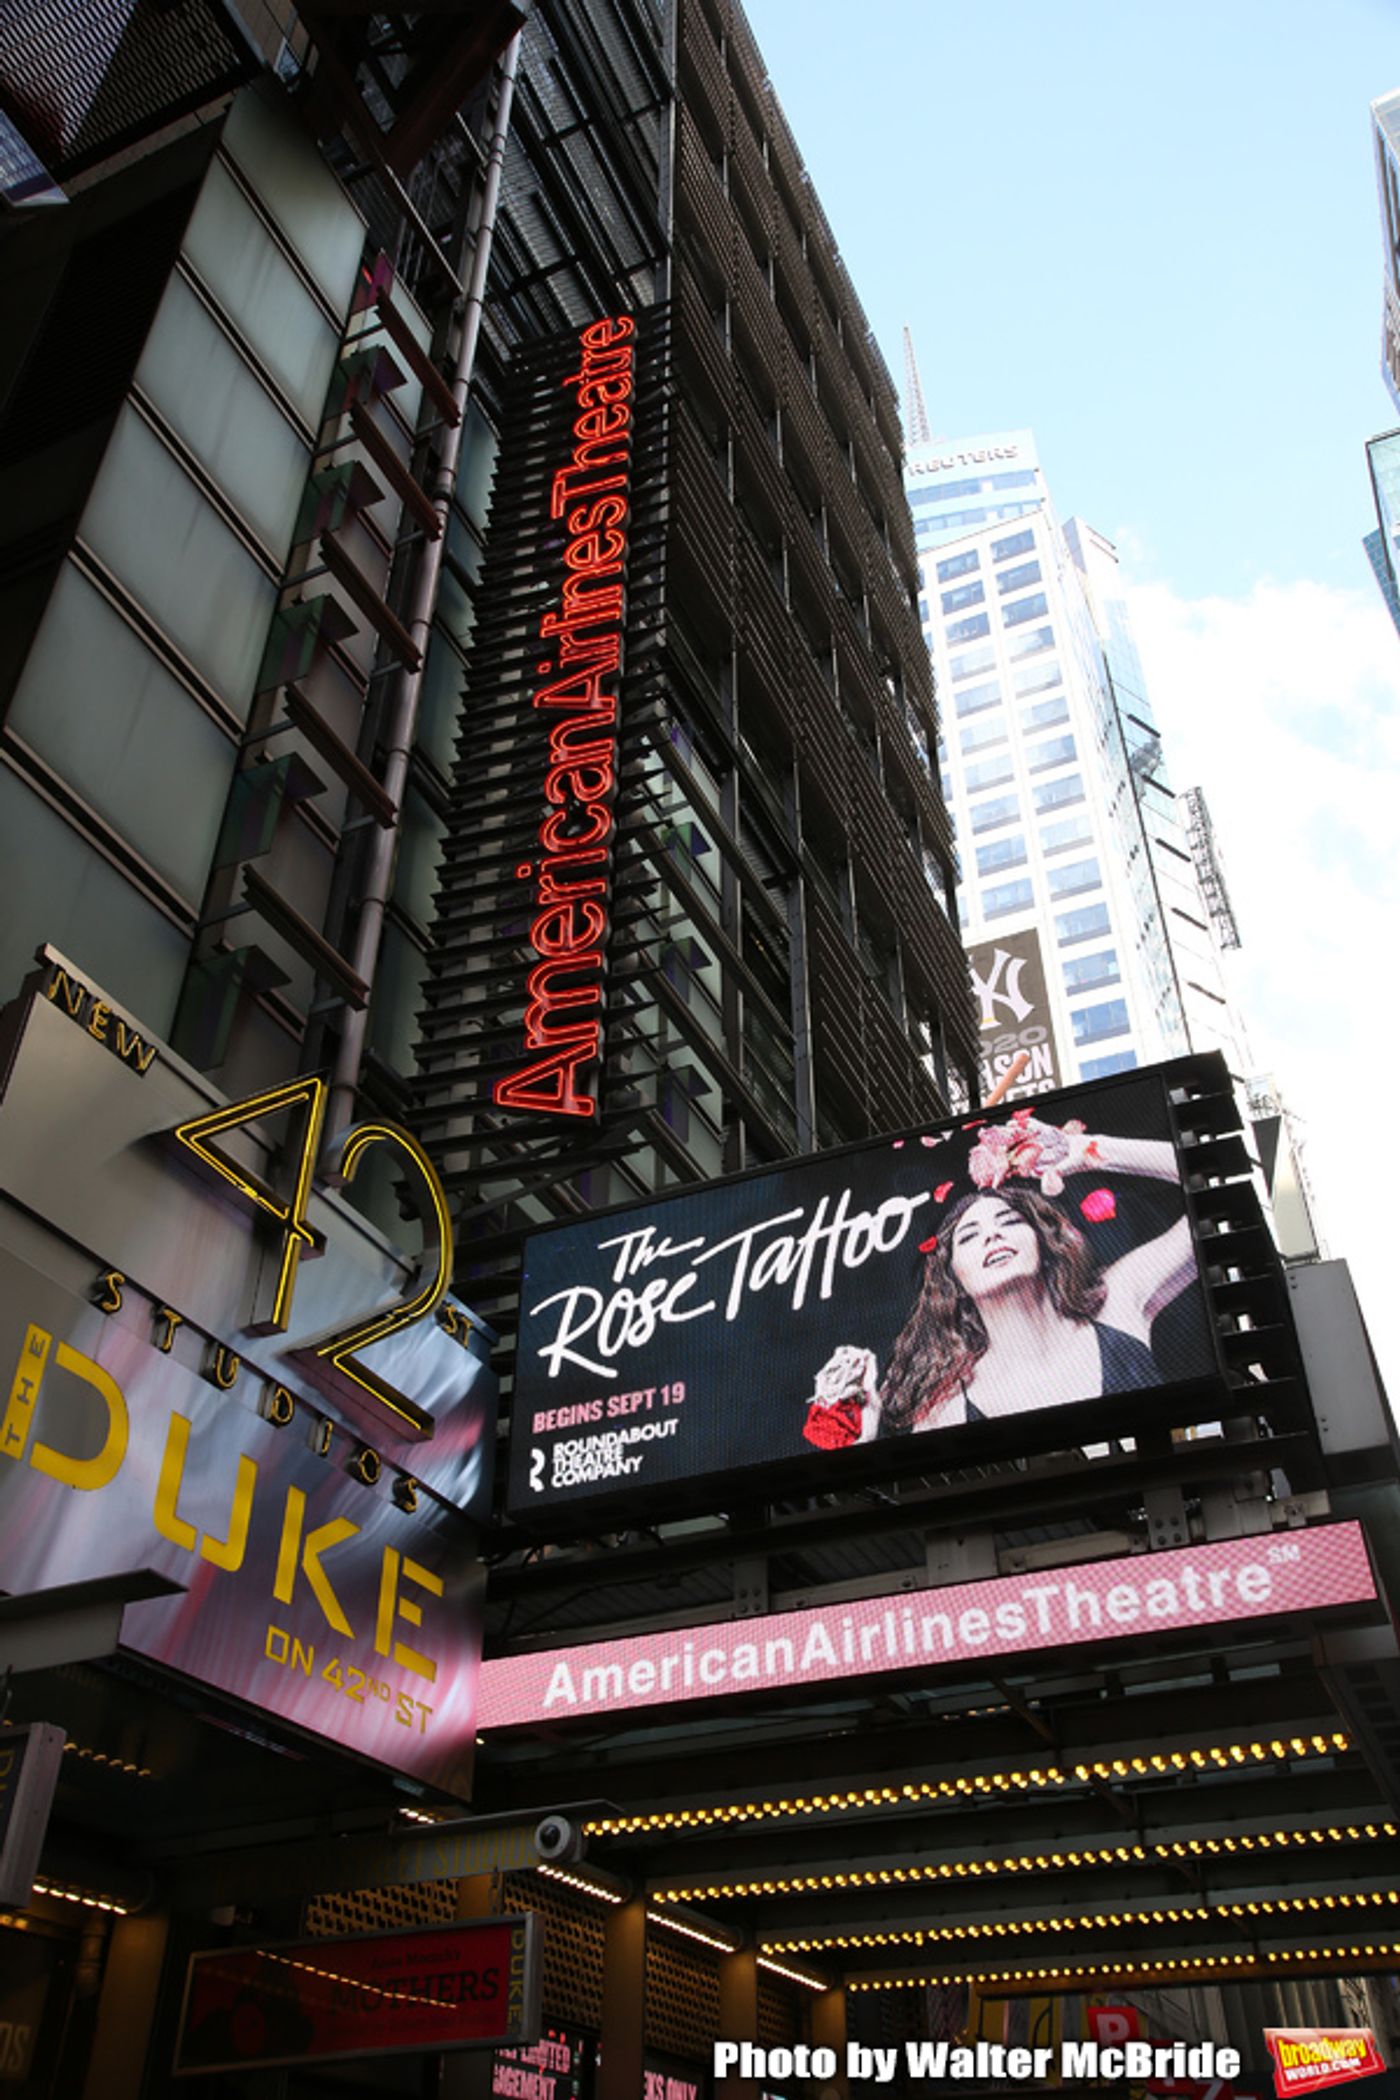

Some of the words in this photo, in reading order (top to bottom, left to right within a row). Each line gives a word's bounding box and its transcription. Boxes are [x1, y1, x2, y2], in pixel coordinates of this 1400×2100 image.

[907, 444, 1018, 477] REUTERS
[48, 966, 156, 1071] NEW
[175, 1076, 454, 1440] 42
[530, 1272, 716, 1378] Rose
[691, 1187, 931, 1322] Tattoo
[598, 1226, 705, 1284] The
[4, 1332, 46, 1447] THE
[98, 1270, 420, 1514] STUDIOS
[532, 1396, 603, 1434] BEGINS
[607, 1387, 657, 1417] SEPT
[661, 1381, 686, 1406] 19
[551, 1455, 643, 1488] COMPANY
[553, 1418, 679, 1460] ROUNDABOUT
[553, 1445, 625, 1473] THEATRE
[30, 1340, 444, 1683] DUKE
[264, 1624, 314, 1676] ON
[395, 1692, 433, 1735] ST
[327, 1967, 499, 2016] MOTHERS
